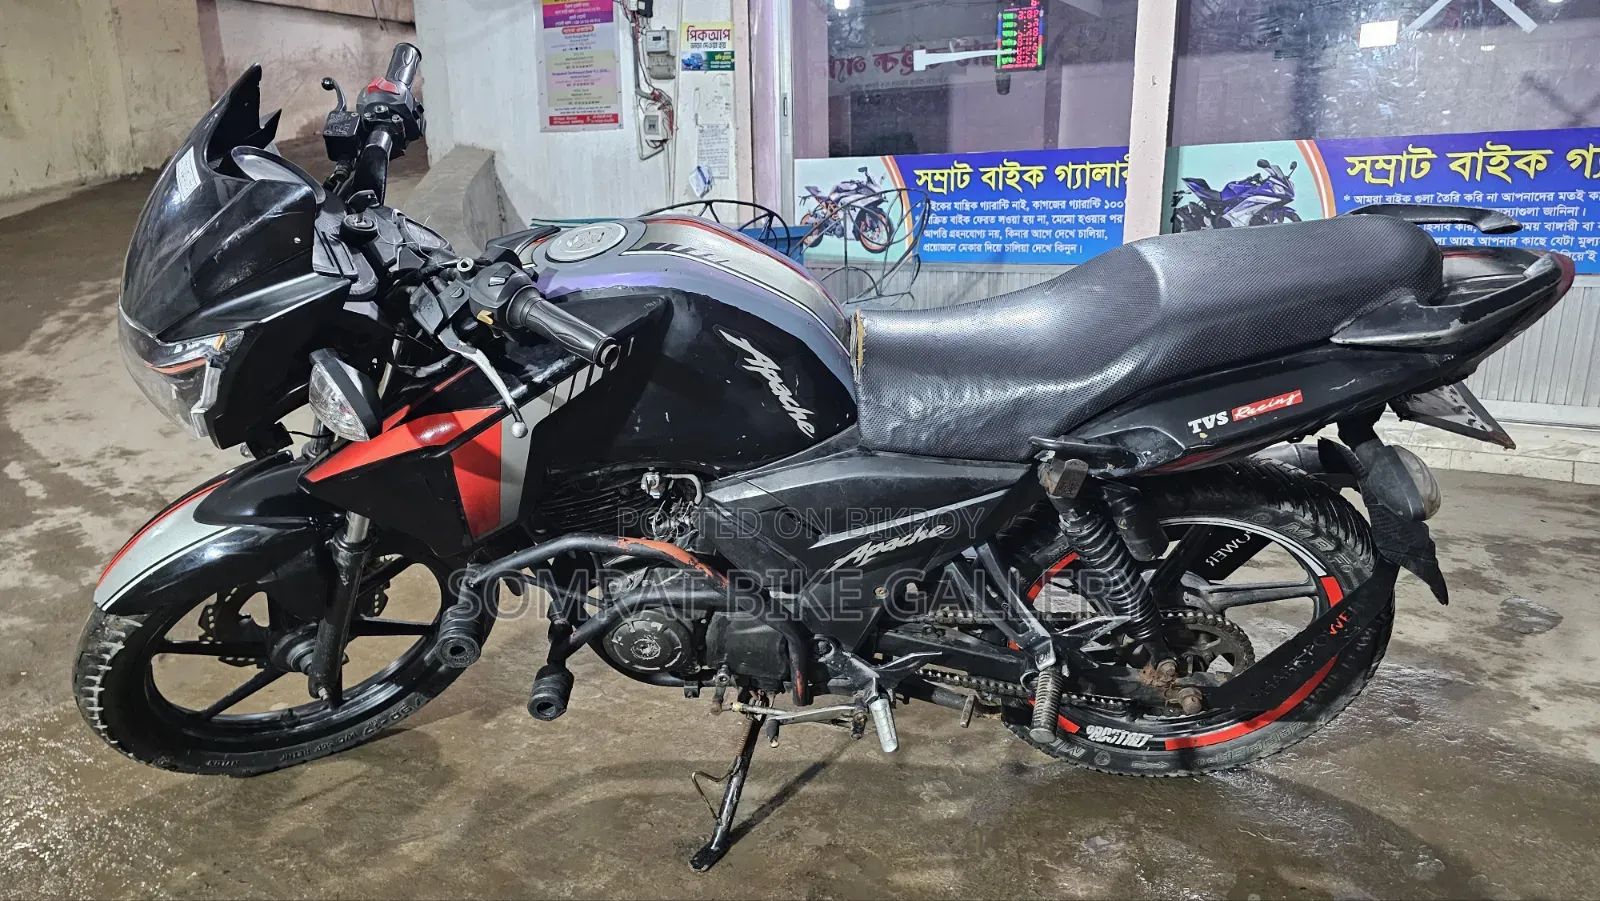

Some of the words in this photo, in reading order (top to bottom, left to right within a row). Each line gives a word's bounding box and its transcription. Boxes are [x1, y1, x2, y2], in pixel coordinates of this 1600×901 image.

[686, 25, 731, 41] পিকআপ
[1343, 143, 1438, 188] সম্রাট
[1446, 141, 1554, 184] বাইক
[913, 160, 974, 195] সম্রাট
[978, 158, 1047, 193] বাইক
[1353, 194, 1383, 204] আমরা
[1384, 192, 1412, 204] বাইক
[1436, 190, 1461, 203] তৈরি
[1463, 190, 1484, 203] করি
[1486, 192, 1499, 202] না
[1501, 191, 1555, 202] আপনাদের
[1558, 189, 1586, 202] মতই
[1032, 199, 1067, 210] কাগজের
[1542, 203, 1580, 217] জানিনা
[950, 214, 971, 225] বাইক
[973, 215, 996, 224] ফেরত
[1022, 215, 1035, 225] হয়
[1051, 214, 1075, 224] মেমো
[1077, 214, 1107, 225] হওয়ার
[1031, 229, 1052, 238] আগে
[1449, 235, 1476, 246] আছে
[1478, 236, 1518, 246] আপনার
[1521, 235, 1548, 246] কাছে
[719, 329, 815, 439] Apache
[1188, 411, 1229, 434] TVS
[1234, 390, 1302, 420] Racing
[823, 522, 952, 574] Apache
